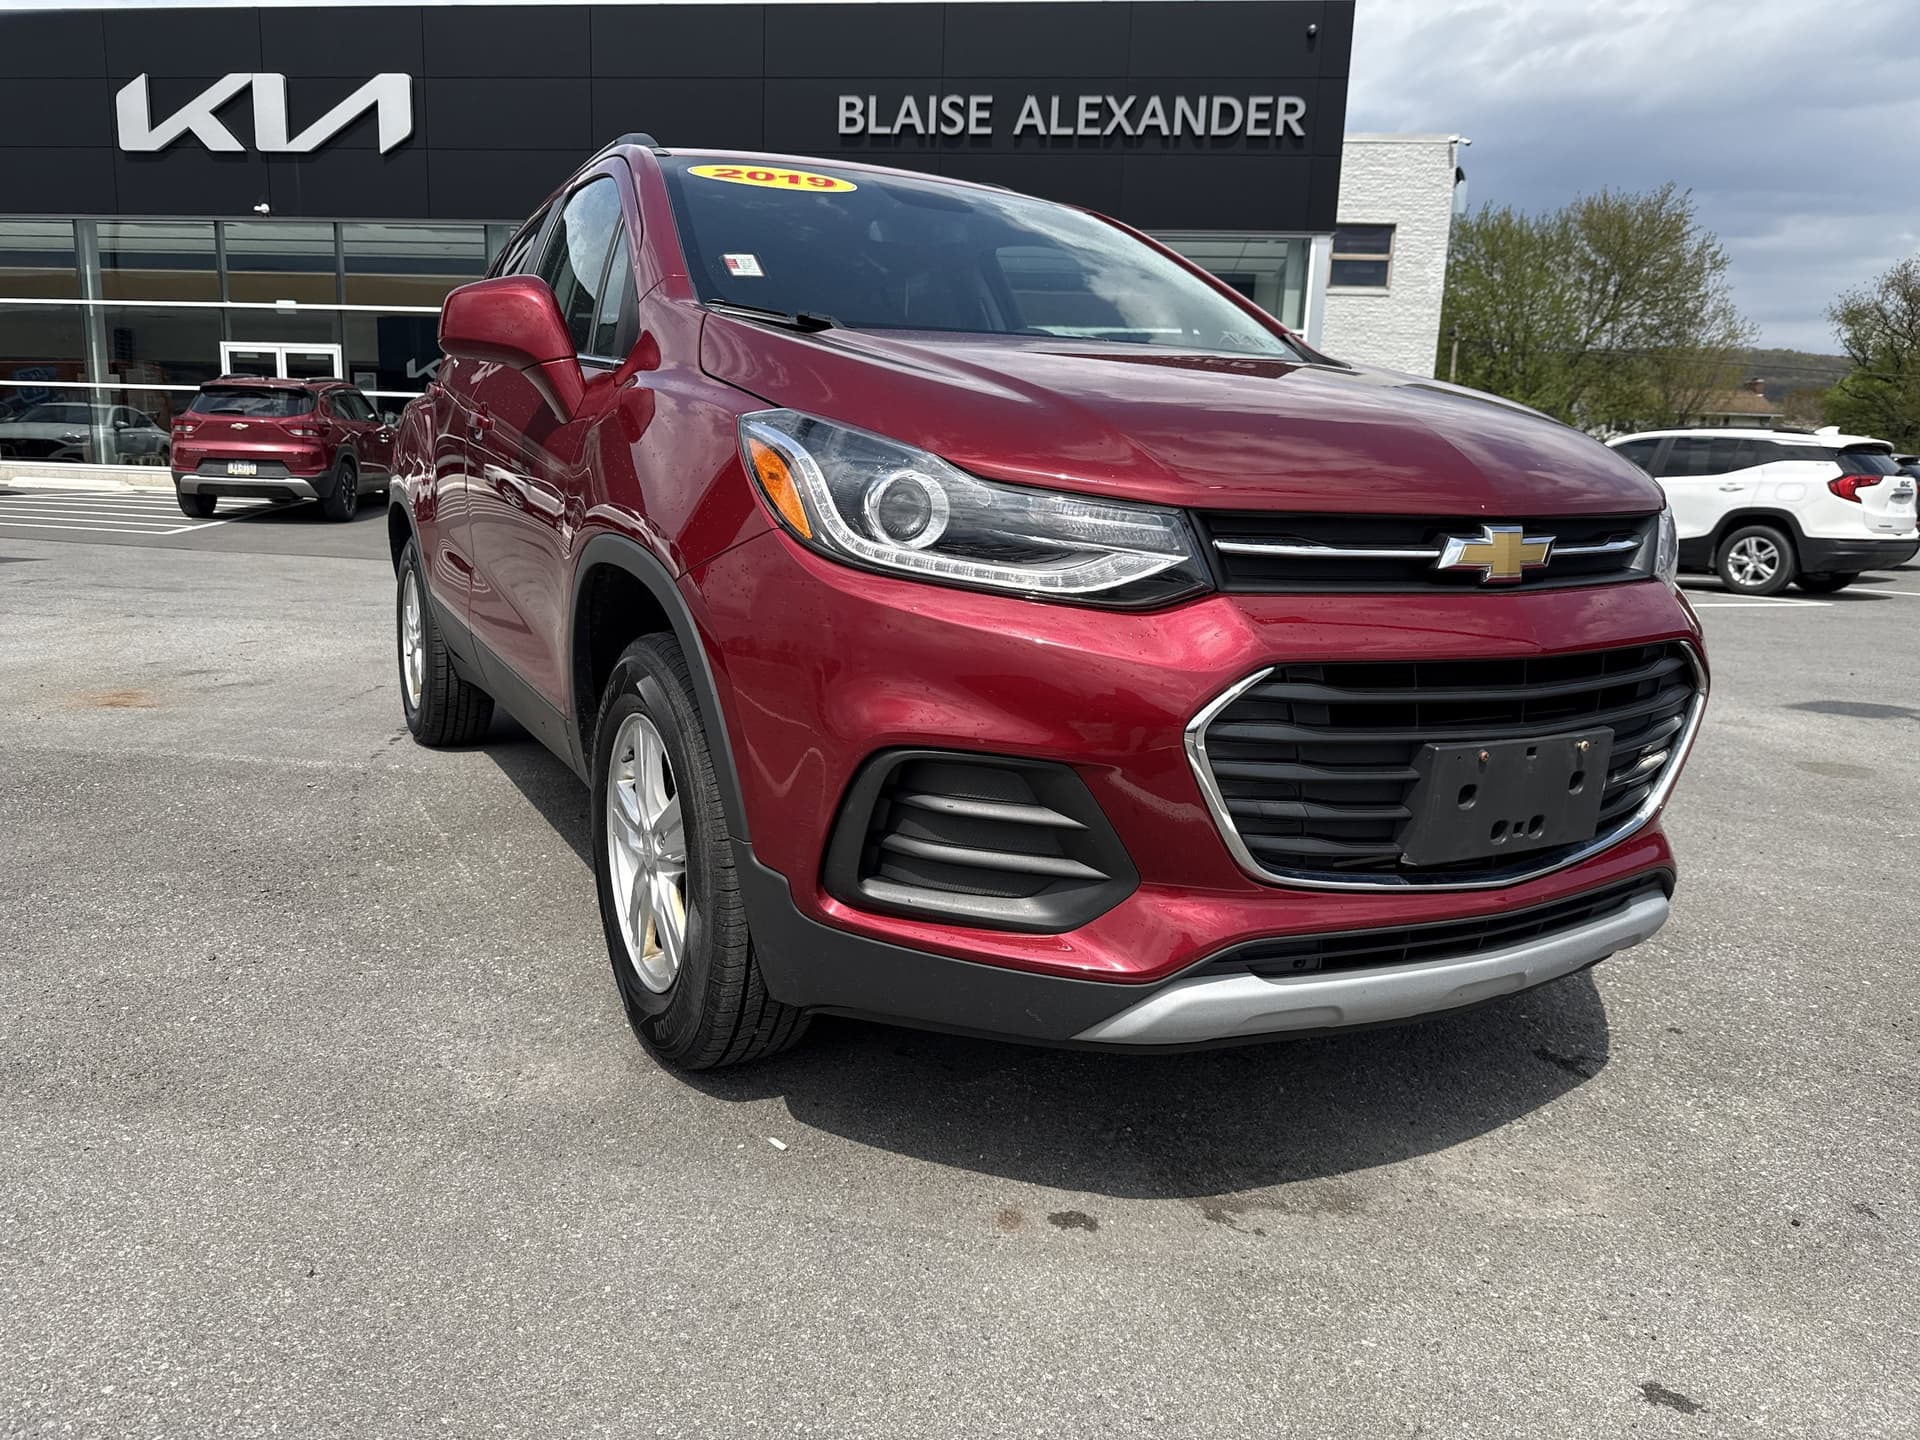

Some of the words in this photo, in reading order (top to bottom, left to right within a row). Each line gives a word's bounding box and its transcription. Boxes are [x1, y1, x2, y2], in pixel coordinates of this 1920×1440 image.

[116, 73, 412, 154] KIA
[838, 95, 993, 135] BLAISE
[1013, 95, 1306, 136] ALEXANDER
[713, 168, 837, 188] 2019
